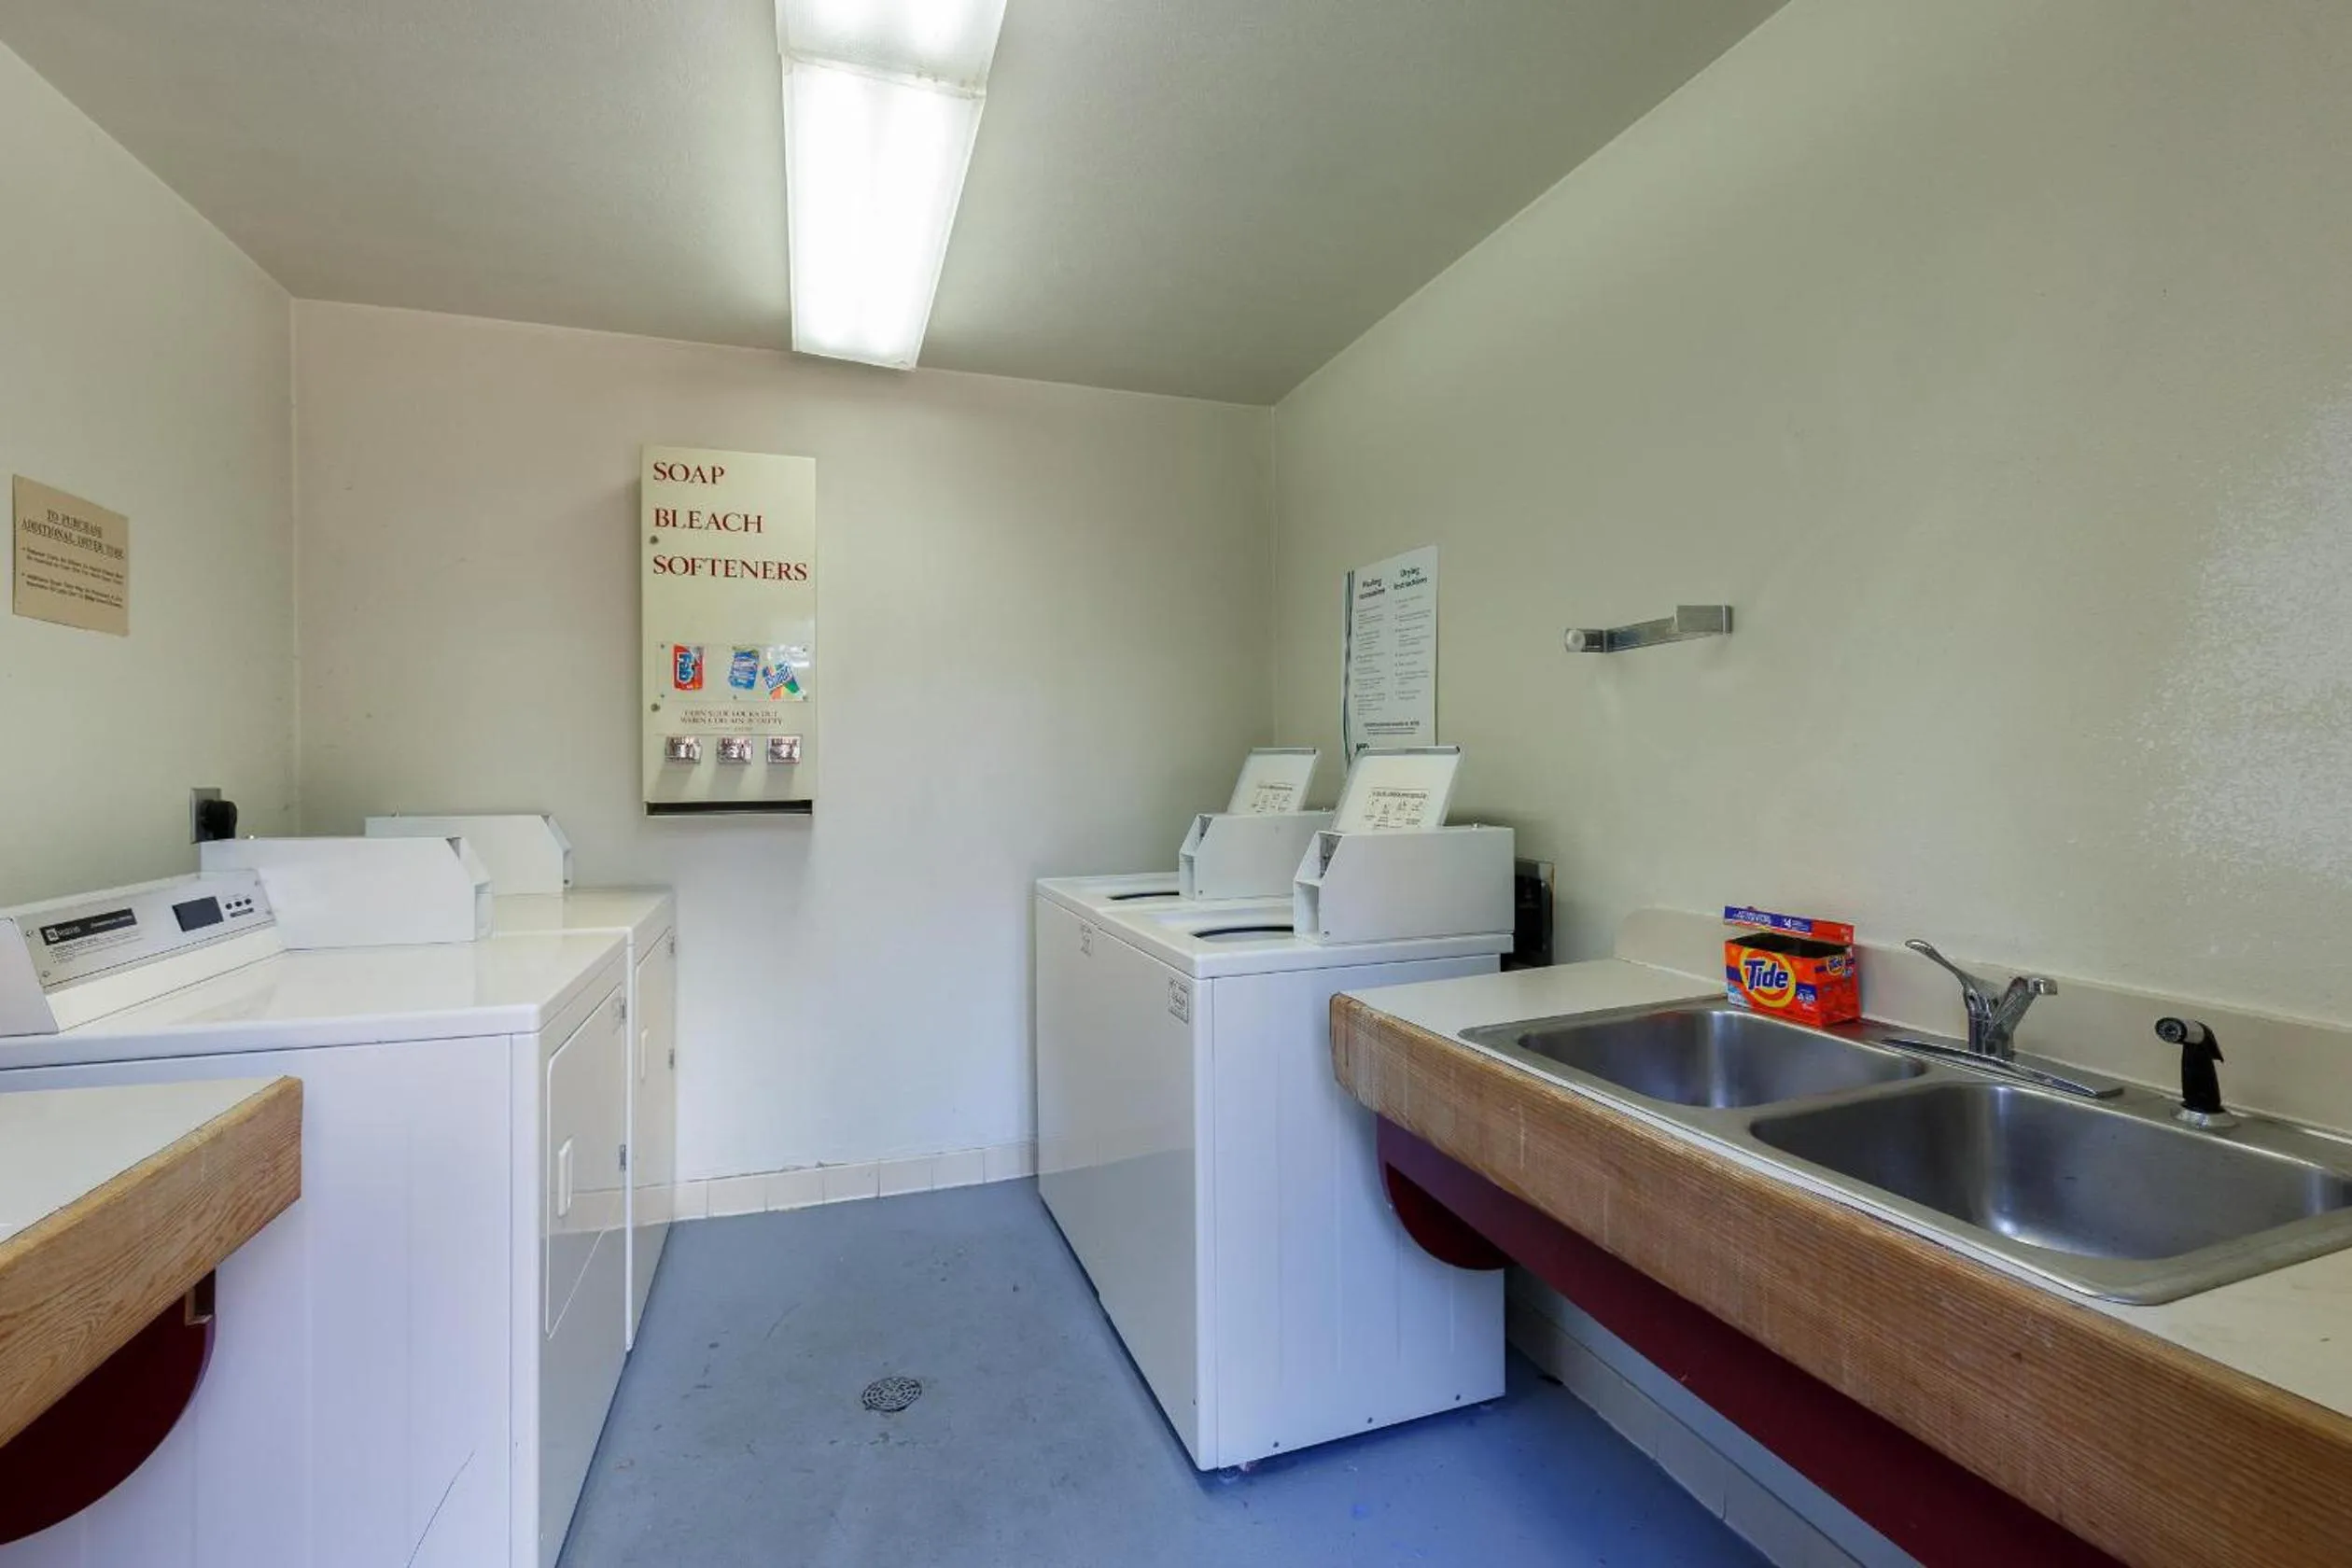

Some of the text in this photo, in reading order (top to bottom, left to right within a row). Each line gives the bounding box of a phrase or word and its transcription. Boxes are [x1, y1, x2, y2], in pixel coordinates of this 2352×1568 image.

[653, 462, 724, 484] SOAP
[654, 509, 763, 533] BLEACH
[652, 555, 807, 581] SOFTENERS
[1743, 959, 1789, 991] Tide
